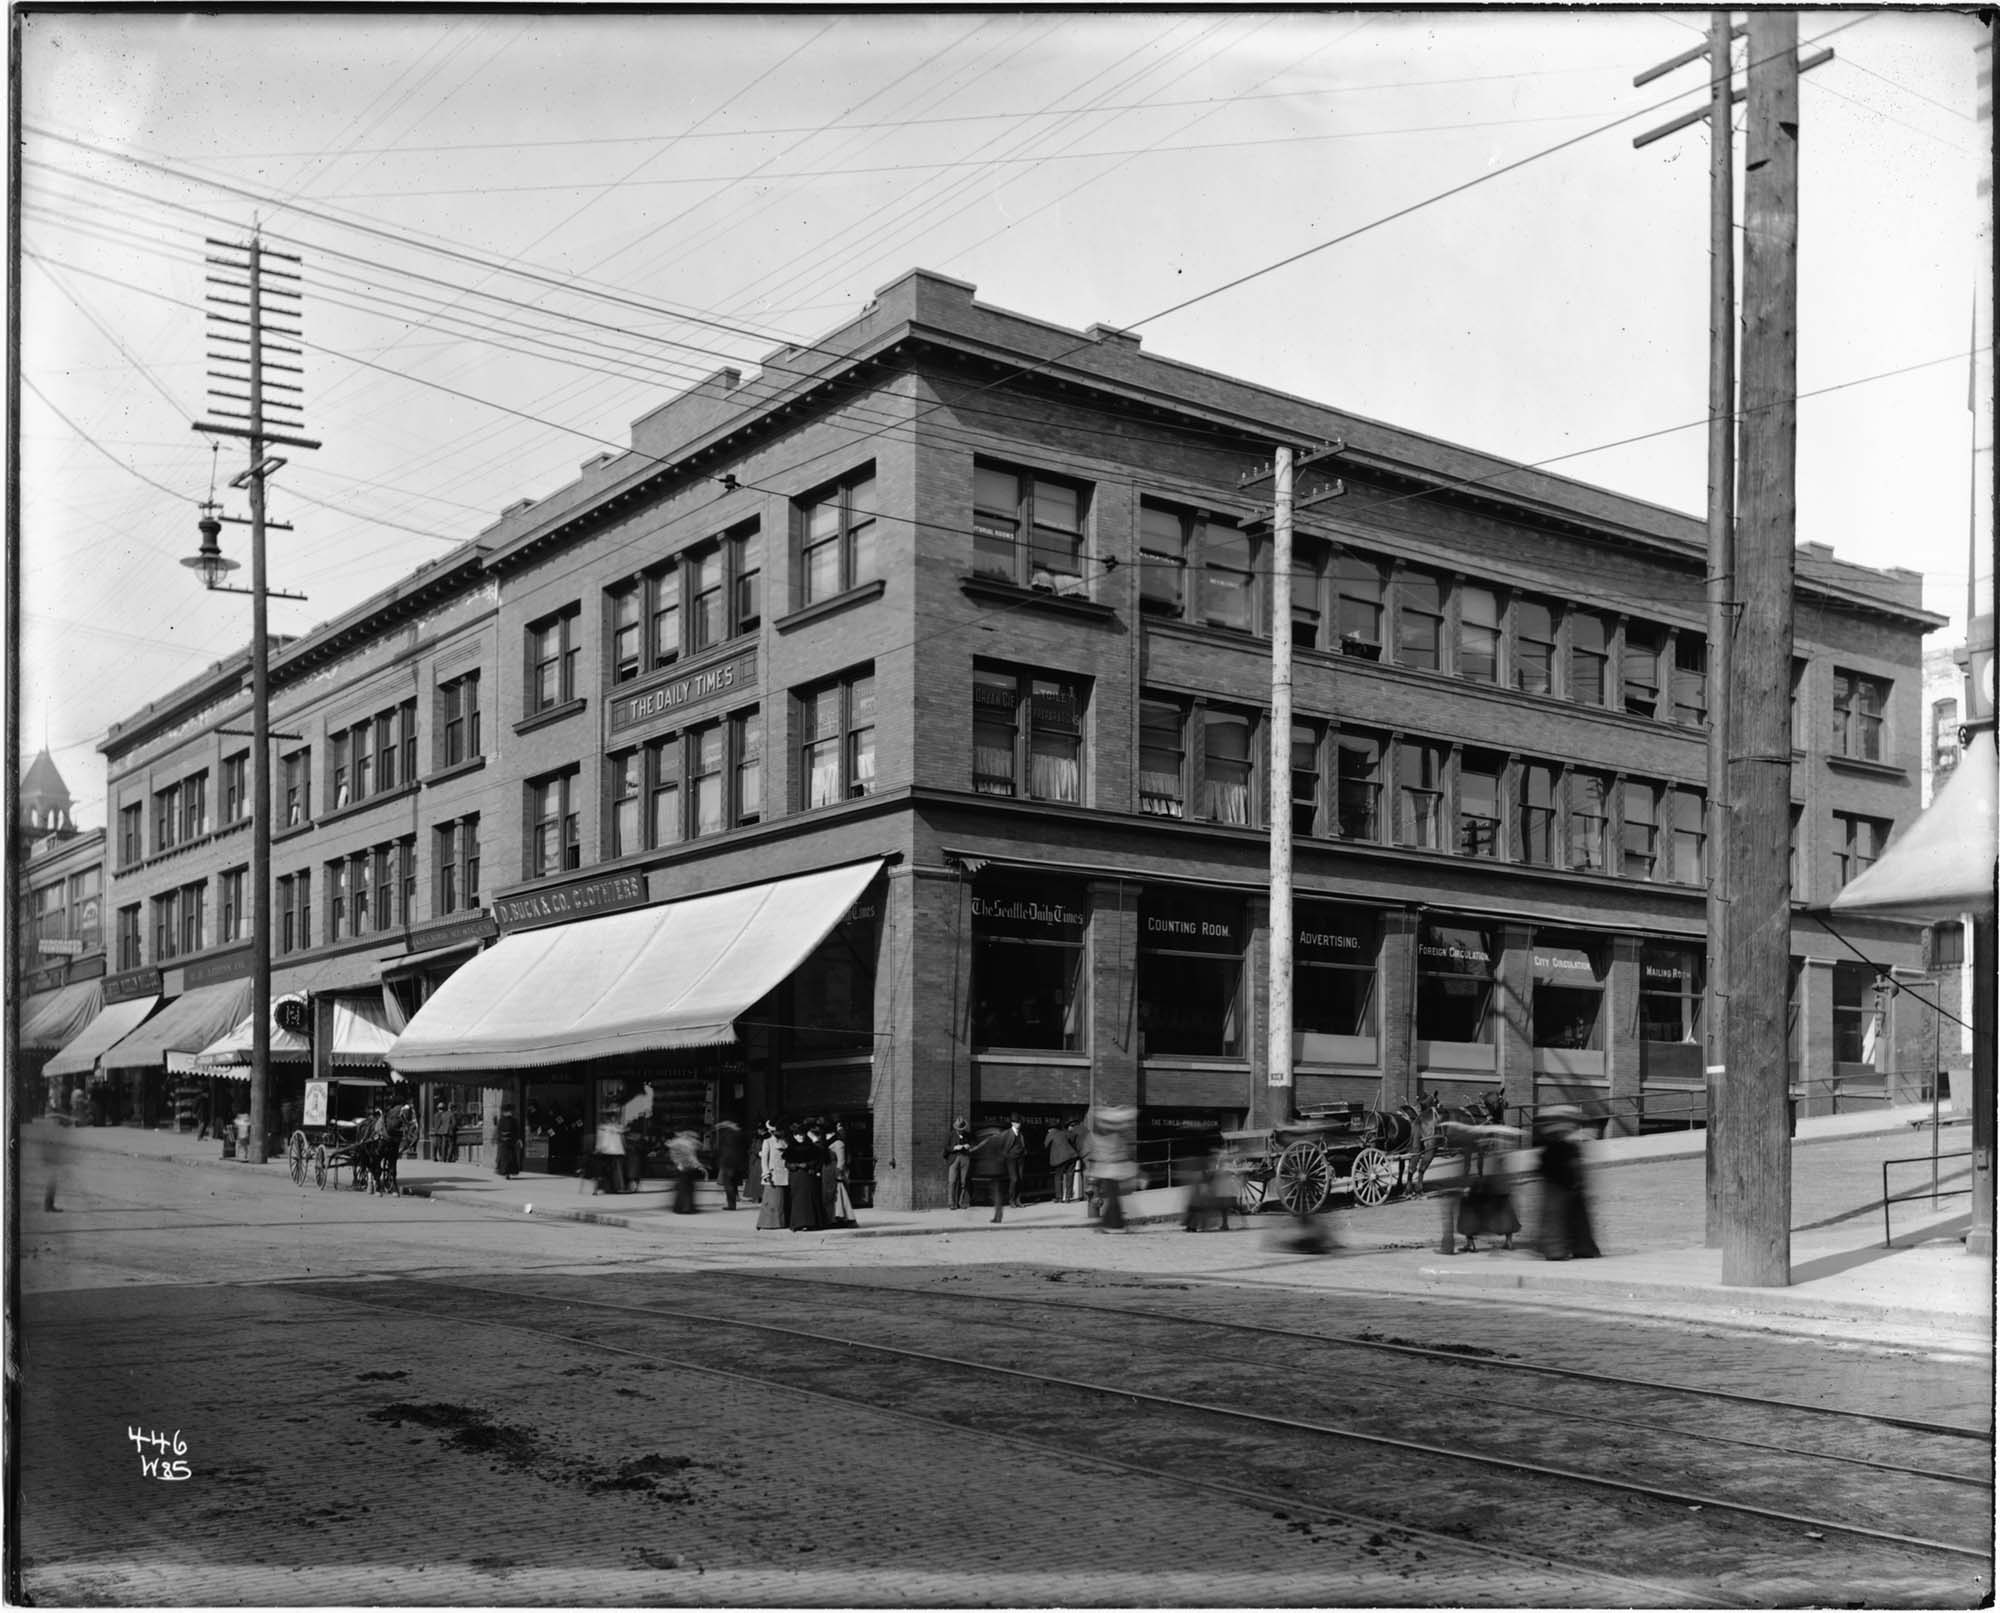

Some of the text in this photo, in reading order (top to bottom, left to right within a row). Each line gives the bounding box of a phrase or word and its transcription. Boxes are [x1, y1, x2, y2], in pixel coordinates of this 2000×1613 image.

[630, 665, 734, 720] THE DAILY TIMES
[540, 896, 552, 915] &
[552, 893, 571, 913] CO.
[572, 876, 639, 909] CLOTHIERS
[972, 897, 1084, 926] The Seattle Daily Times
[1148, 917, 1197, 935] COUNTING
[1299, 930, 1361, 949] ADVERTISING.
[1418, 943, 1447, 957] FOREIGN
[1534, 955, 1550, 968] CITY
[1646, 965, 1672, 978] MAILING
